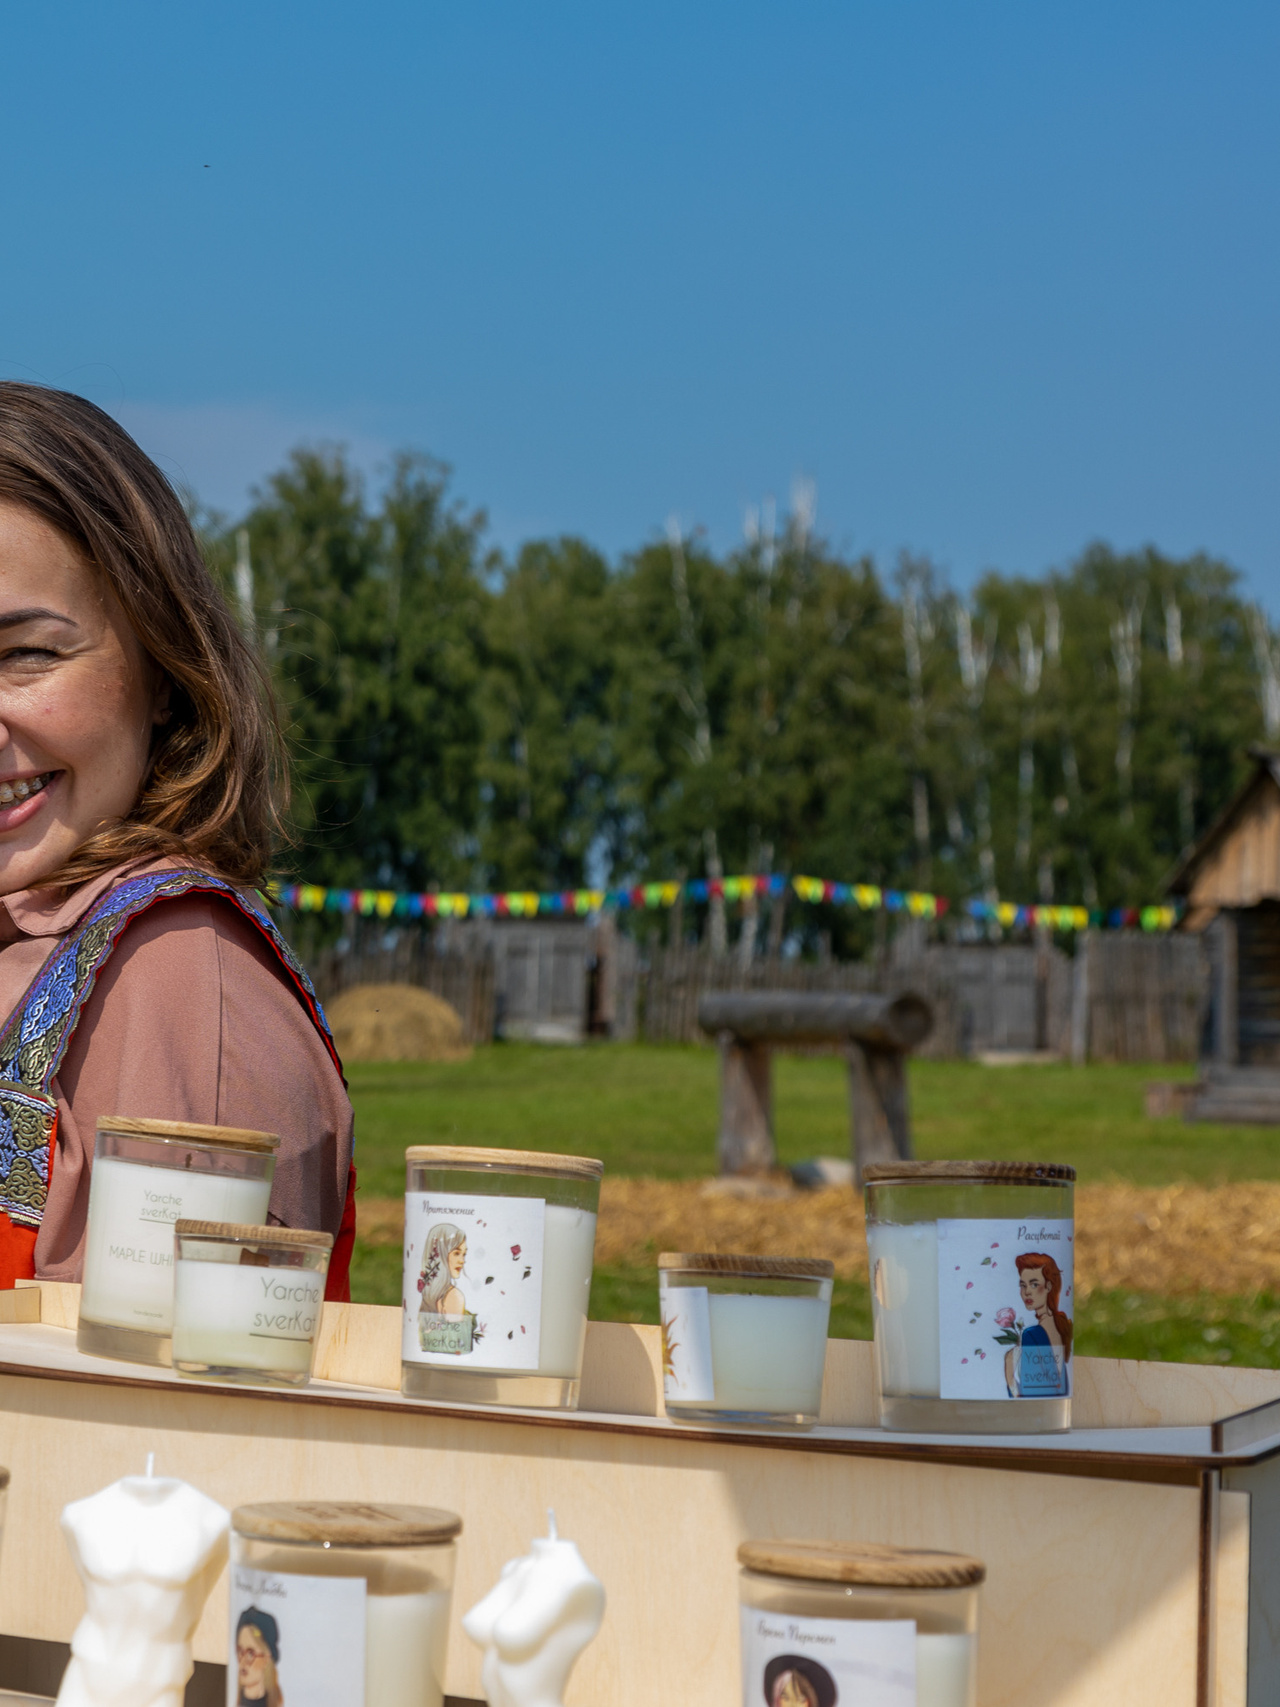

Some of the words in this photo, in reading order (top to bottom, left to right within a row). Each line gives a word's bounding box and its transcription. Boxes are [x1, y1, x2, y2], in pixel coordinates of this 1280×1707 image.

[143, 1188, 183, 1206] Yarche
[140, 1207, 182, 1220] sverKat
[1017, 1225, 1061, 1244] Расцветай
[109, 1244, 146, 1263] MAPLE
[150, 1251, 174, 1267] WHI
[260, 1275, 320, 1304] Yarche
[253, 1310, 317, 1333] sverKat
